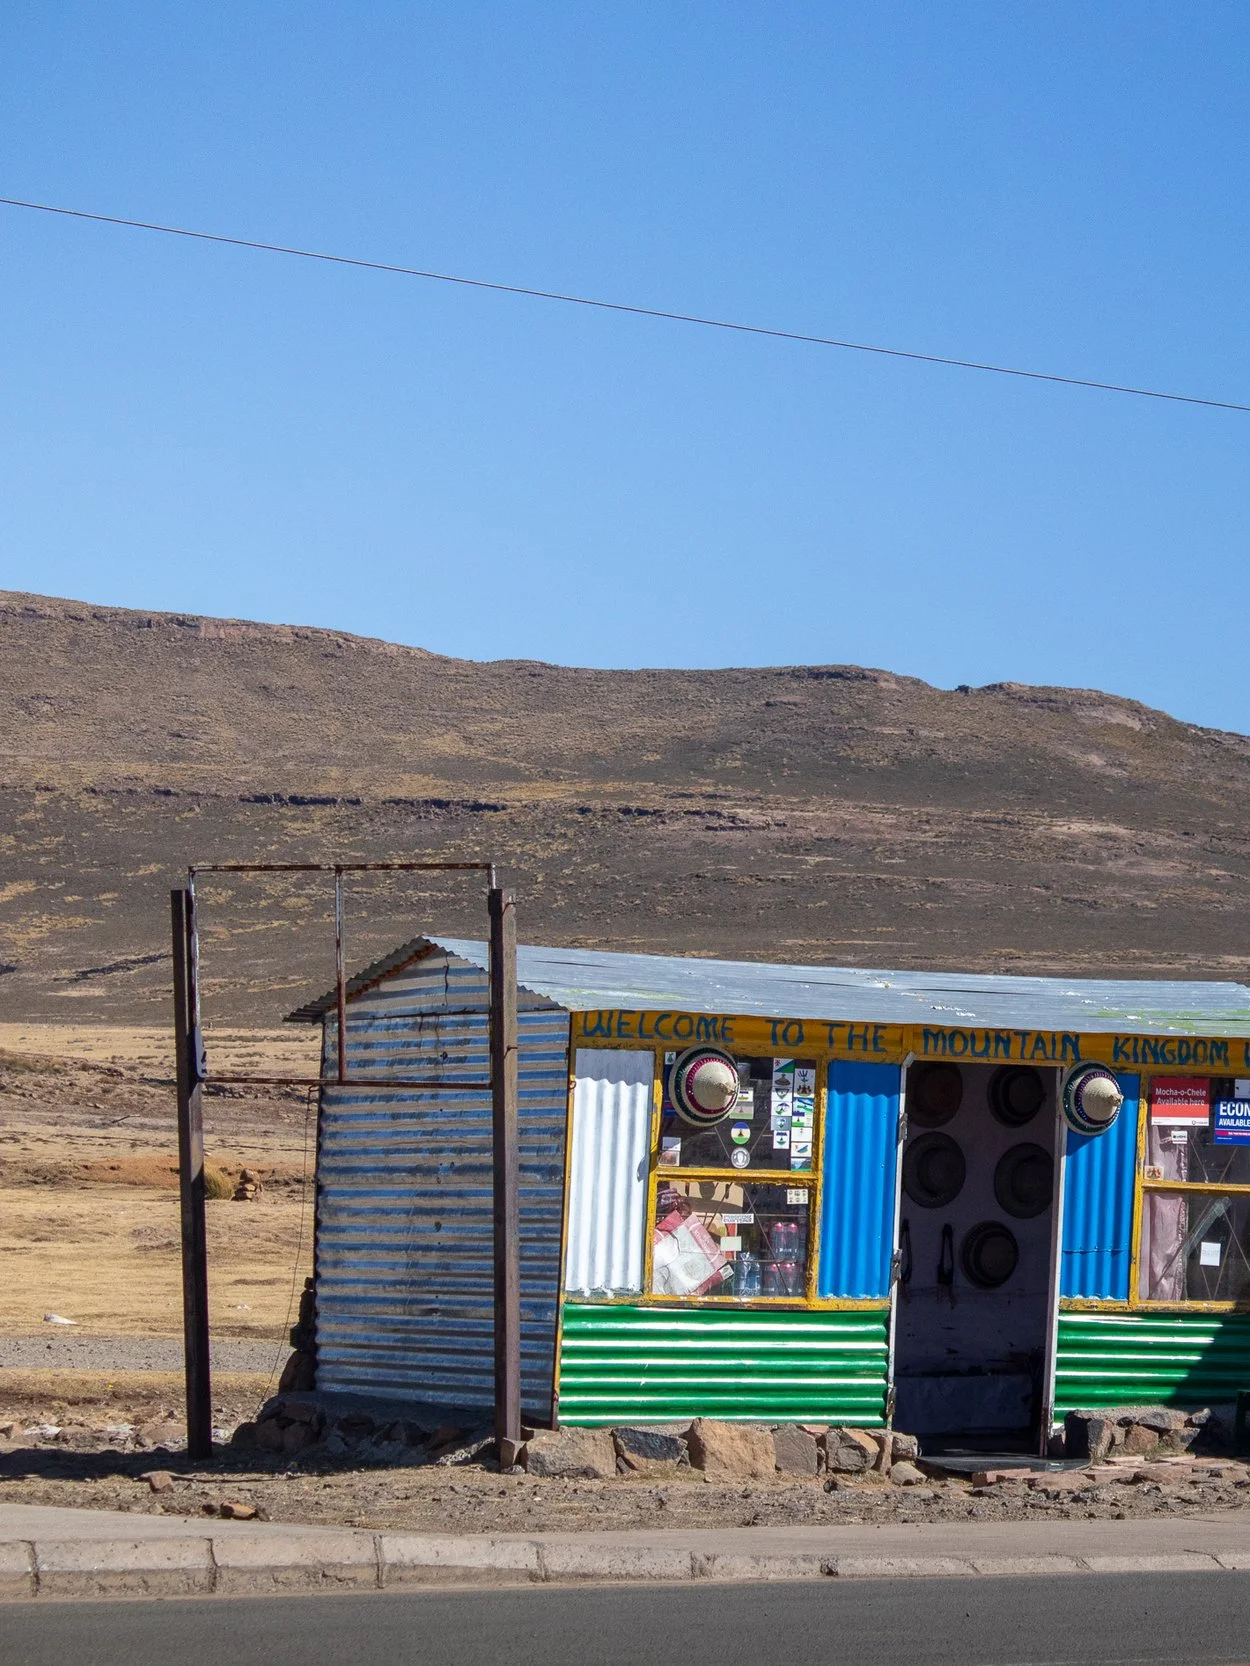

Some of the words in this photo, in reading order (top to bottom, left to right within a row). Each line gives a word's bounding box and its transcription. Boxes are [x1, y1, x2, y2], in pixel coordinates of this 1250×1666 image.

[582, 1010, 736, 1043] WELCOME
[765, 1018, 805, 1047] TO
[823, 1022, 889, 1053] THE
[922, 1028, 1081, 1061] MOUNTAIN
[1113, 1036, 1230, 1067] KINGDOM
[1156, 1097, 1189, 1105] Available
[1189, 1097, 1205, 1106] here
[1218, 1118, 1250, 1127] AVAILABLE
